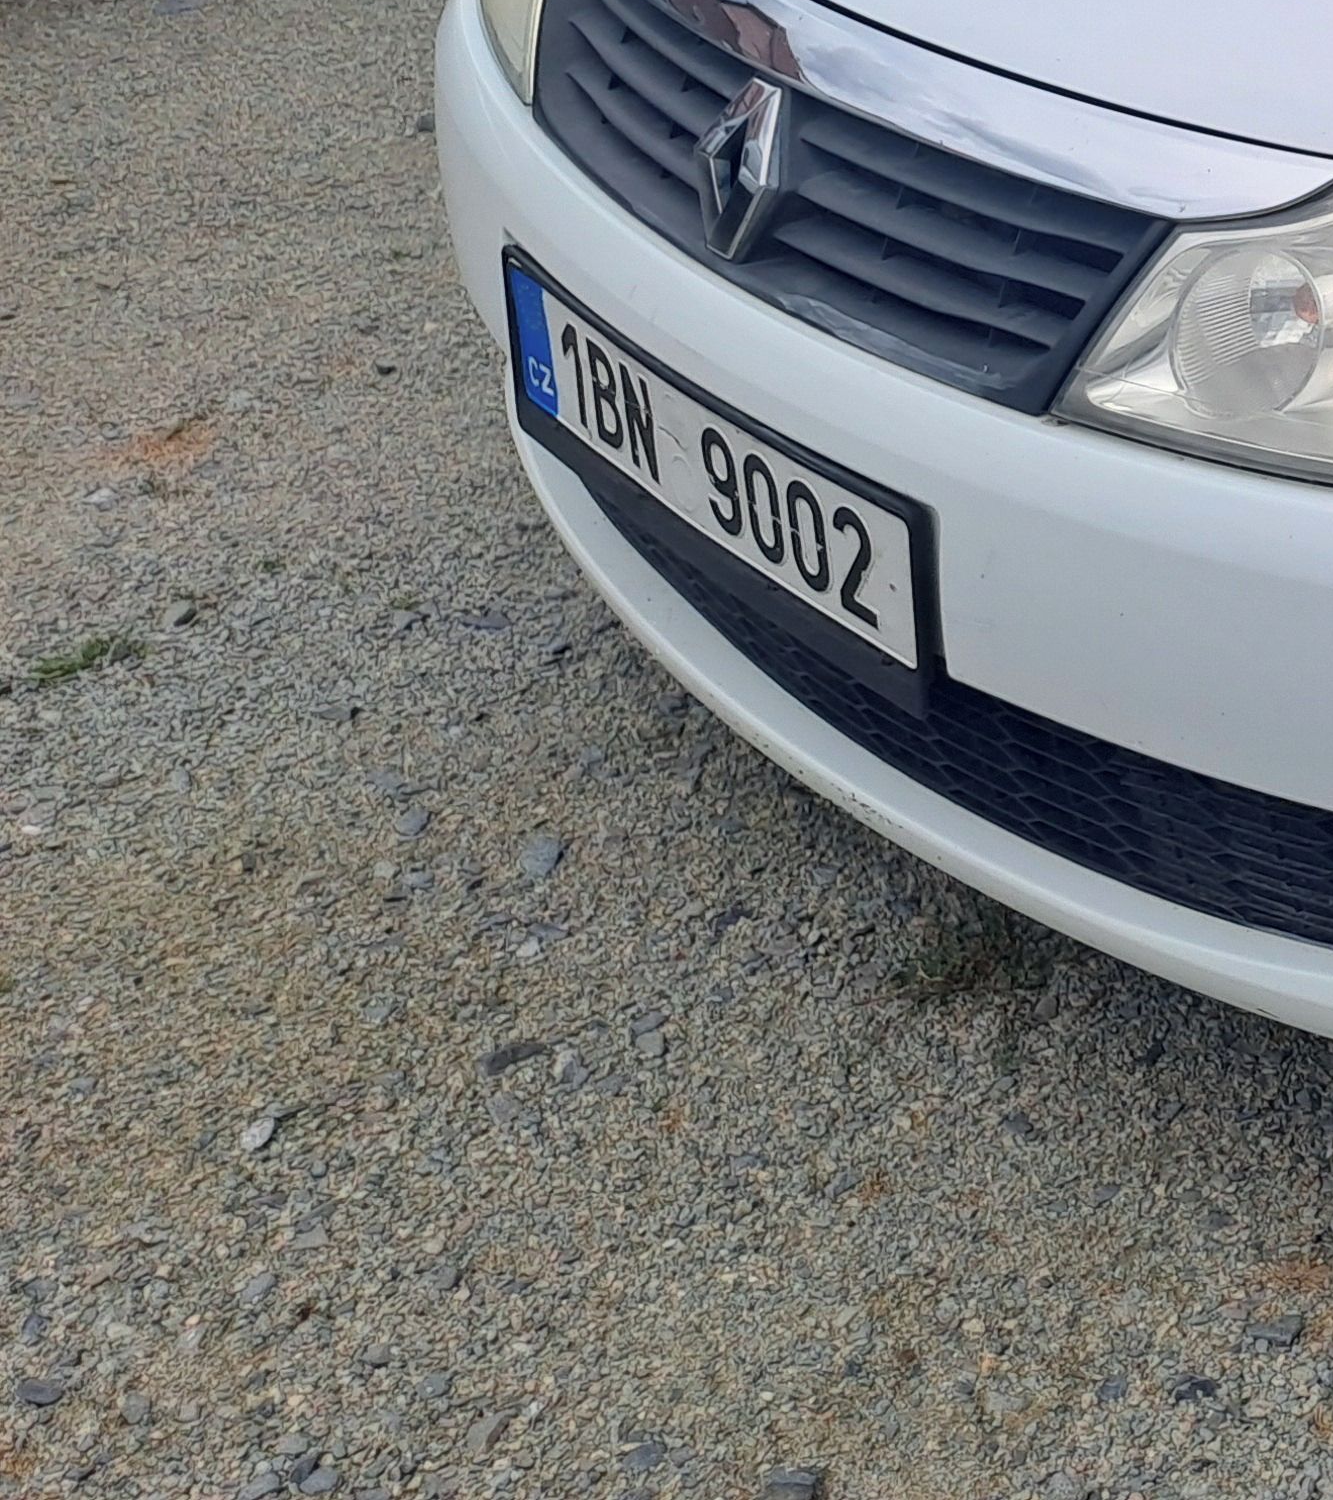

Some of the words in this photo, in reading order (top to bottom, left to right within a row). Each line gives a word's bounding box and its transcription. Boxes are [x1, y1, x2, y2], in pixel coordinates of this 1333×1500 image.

[528, 356, 555, 397] CZ
[561, 321, 661, 486] 1BN
[700, 425, 880, 631] 9002
